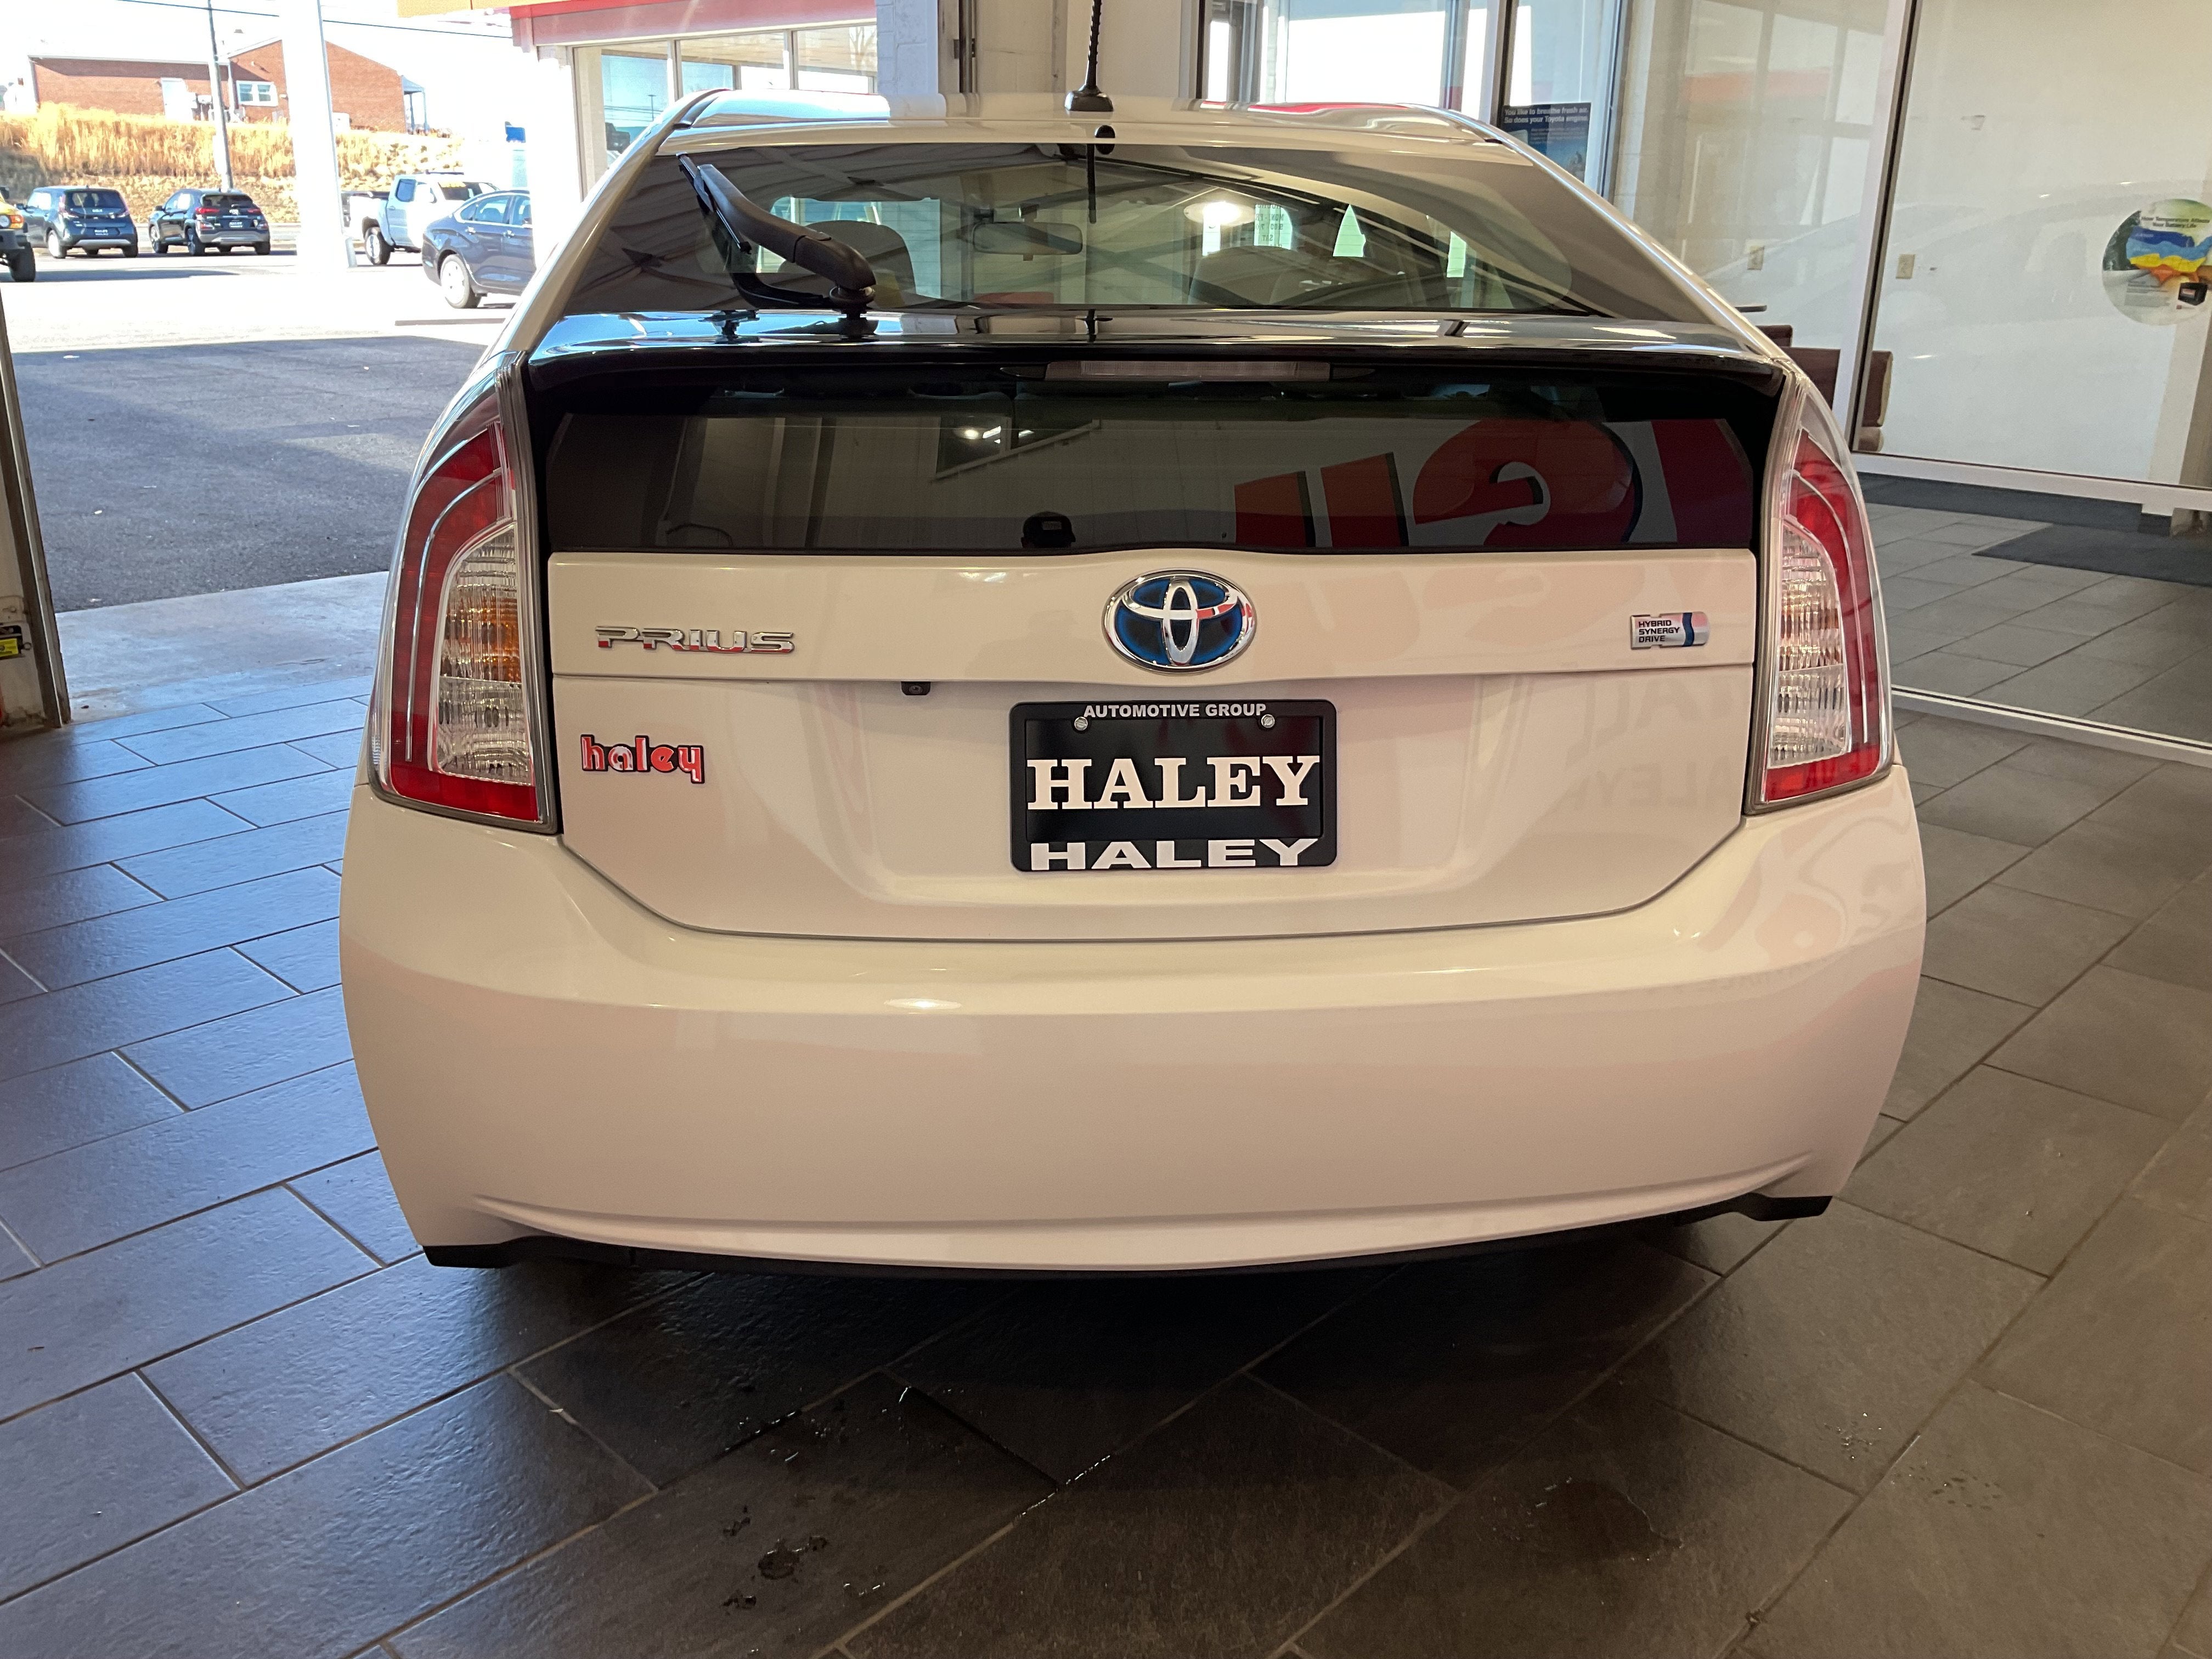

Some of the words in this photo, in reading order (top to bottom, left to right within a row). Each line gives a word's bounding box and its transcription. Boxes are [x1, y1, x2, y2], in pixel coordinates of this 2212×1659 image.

[595, 625, 795, 654] PRIUS
[1083, 704, 1200, 718] AUTOMOTIVE
[1205, 703, 1267, 716] GROUP
[580, 733, 705, 784] haley
[1026, 755, 1321, 810] HALEY
[1030, 838, 1319, 871] HALEY
